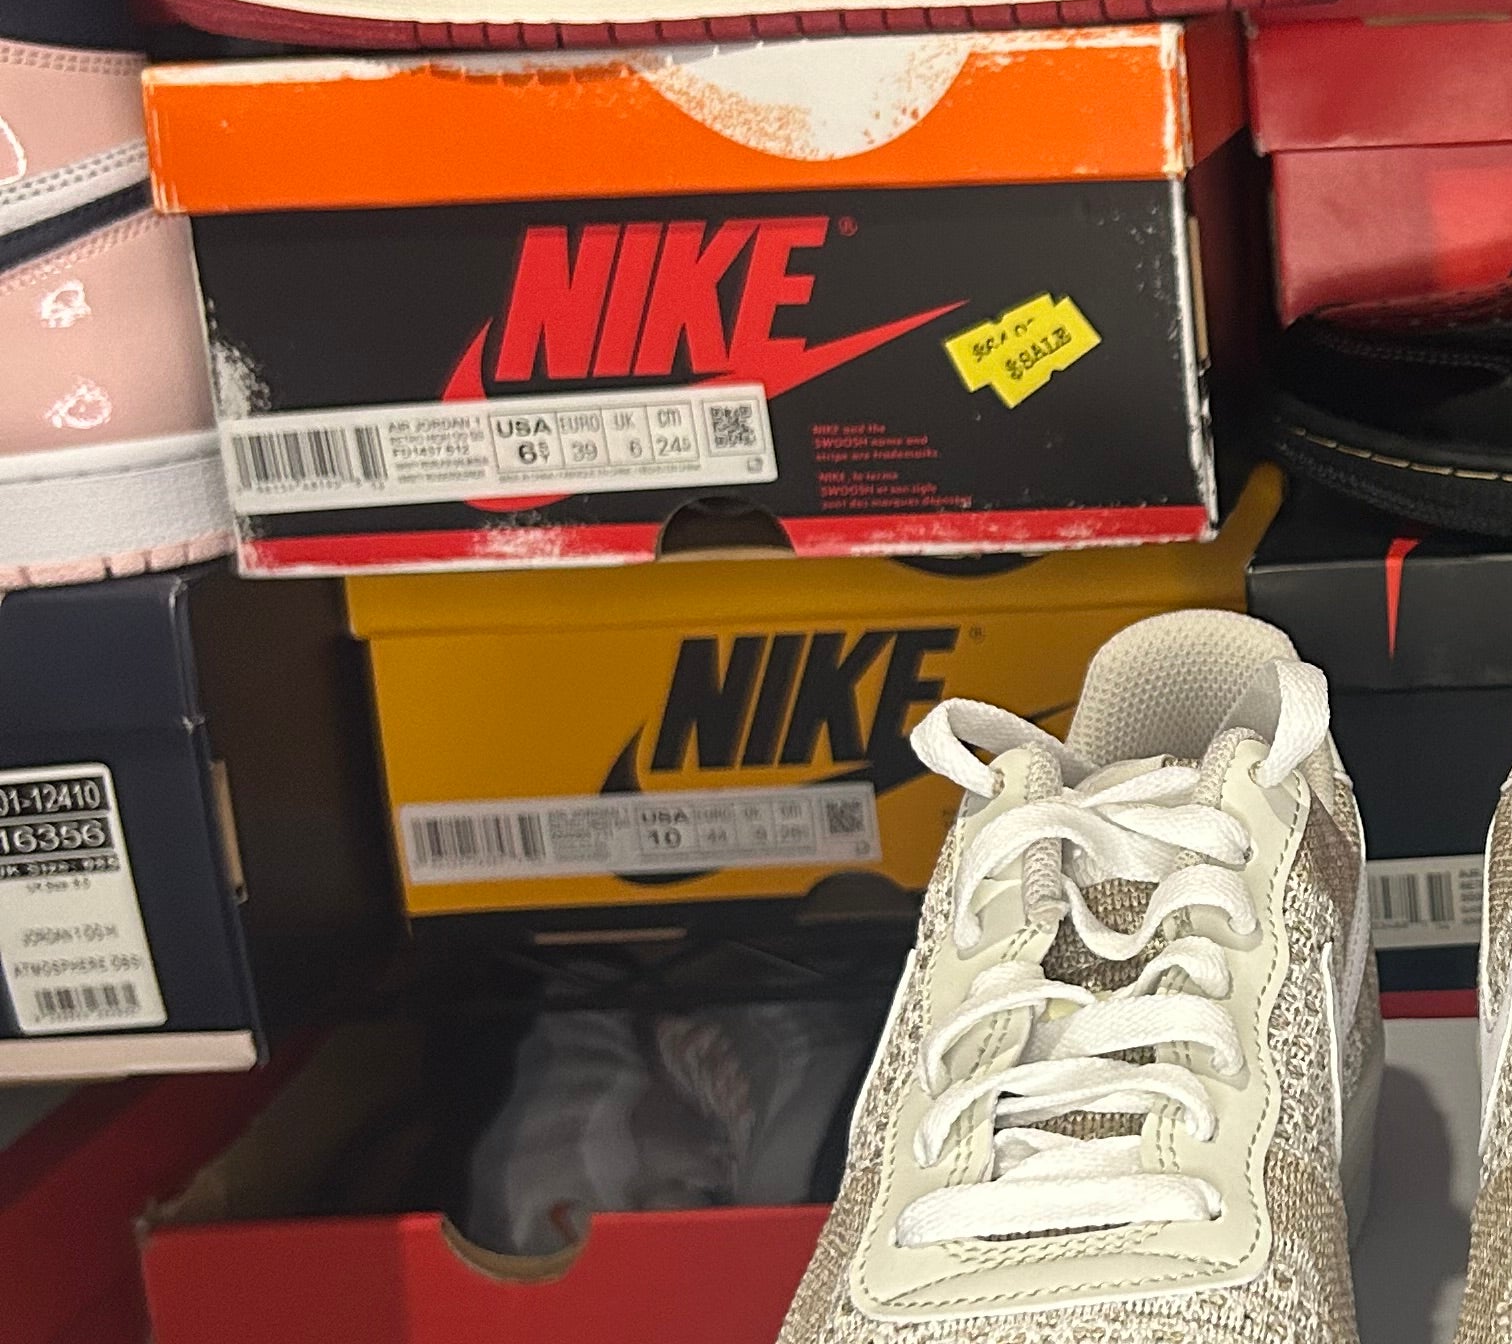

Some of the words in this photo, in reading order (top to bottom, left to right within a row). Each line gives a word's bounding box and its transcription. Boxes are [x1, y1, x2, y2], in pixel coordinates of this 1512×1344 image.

[496, 215, 829, 382] NIKE
[496, 418, 553, 439] USA
[559, 412, 600, 435] EURO
[613, 411, 635, 431] UK
[650, 626, 960, 774] NIKE
